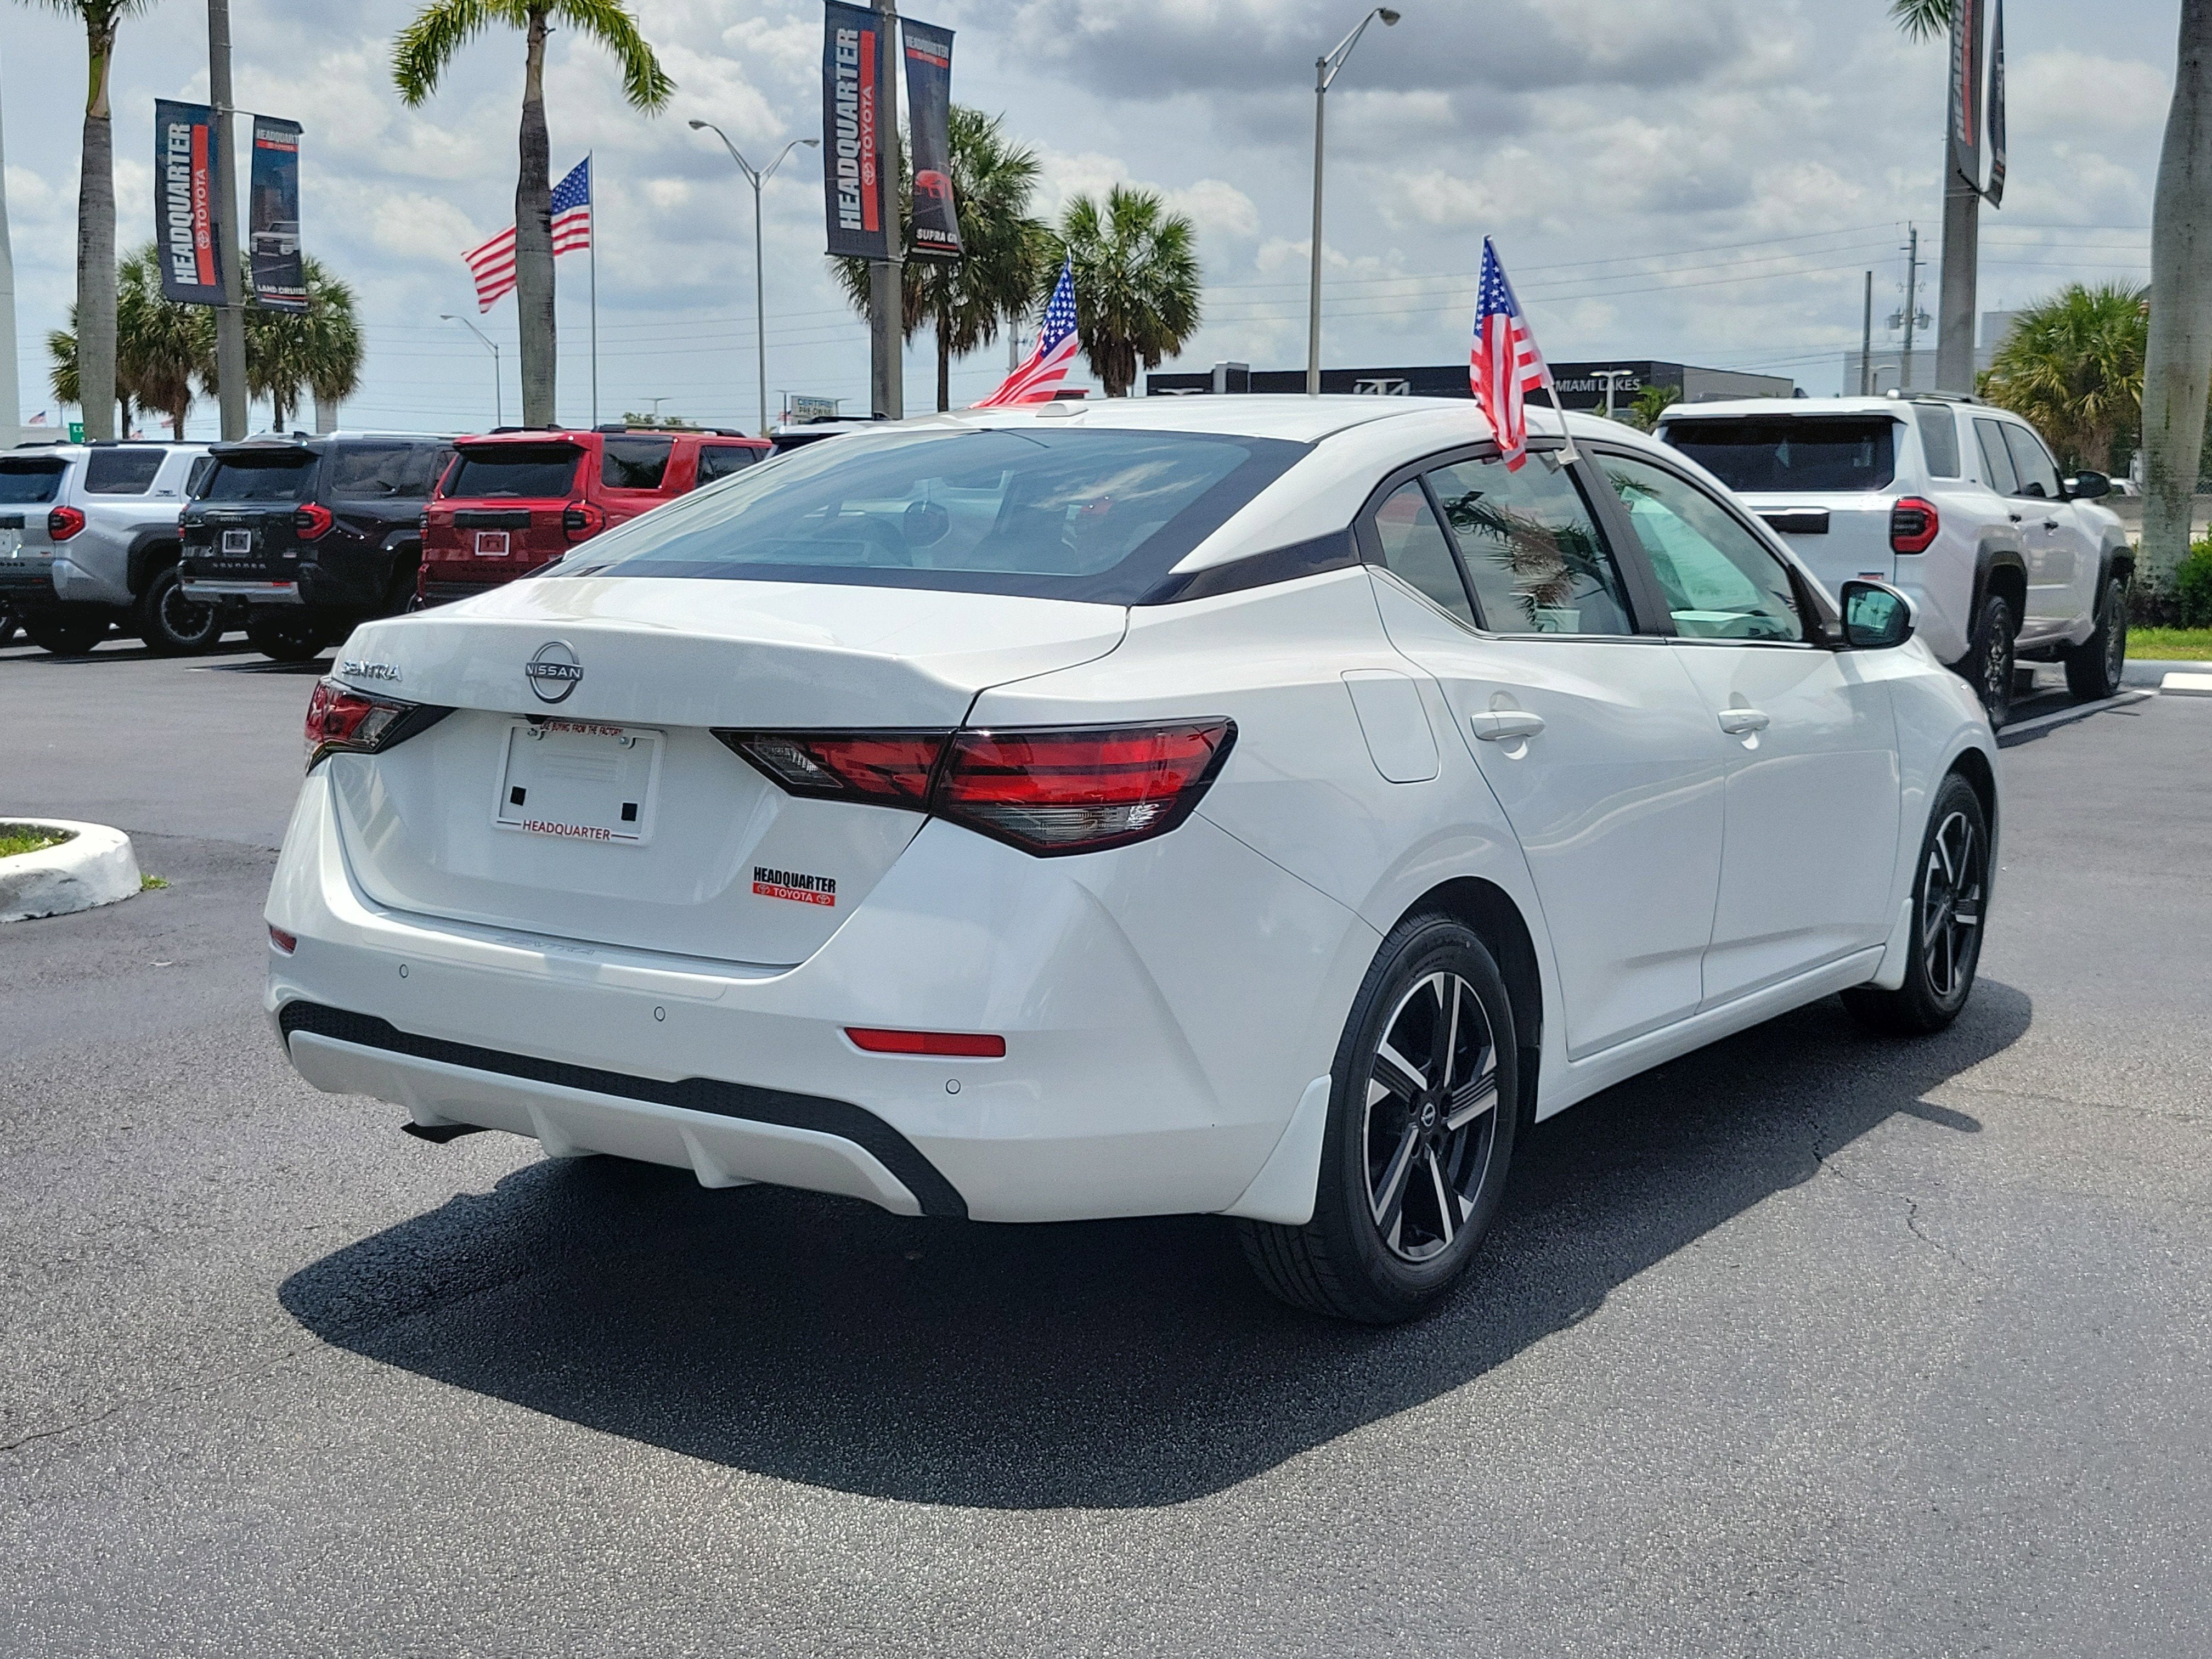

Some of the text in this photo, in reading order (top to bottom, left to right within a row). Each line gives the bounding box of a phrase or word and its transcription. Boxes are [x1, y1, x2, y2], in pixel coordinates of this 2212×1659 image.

[836, 28, 861, 230] HEADQUARTER
[862, 86, 873, 158] TOYOTA
[167, 124, 198, 285] HEADQUARTER
[196, 168, 207, 227] TOYOTA
[916, 228, 945, 242] SUPRA
[257, 285, 277, 293] LAND
[1555, 379, 1640, 392] MIAMI LKES
[342, 659, 402, 682] SENTRA
[527, 664, 580, 678] NISSAN
[523, 820, 610, 840] HEADQUARTER
[754, 866, 836, 893] HEADQUARTER
[774, 887, 813, 902] TOYOTA
